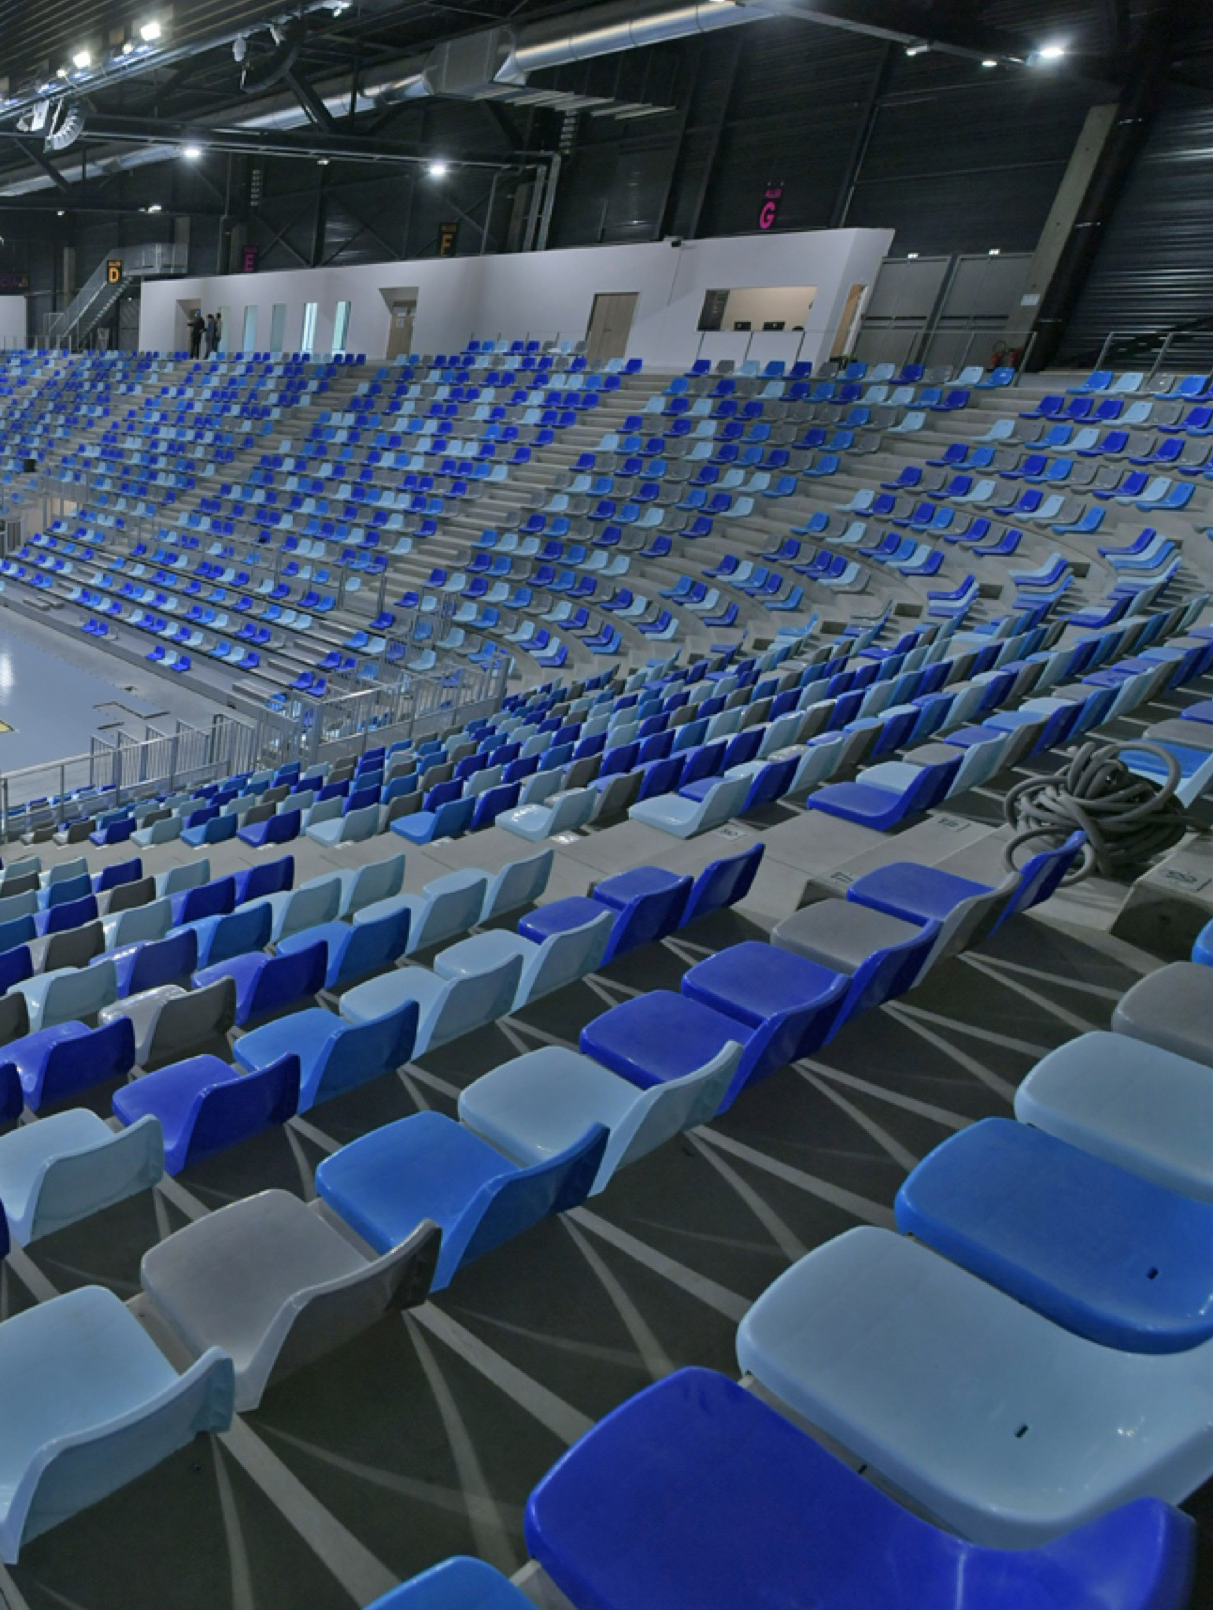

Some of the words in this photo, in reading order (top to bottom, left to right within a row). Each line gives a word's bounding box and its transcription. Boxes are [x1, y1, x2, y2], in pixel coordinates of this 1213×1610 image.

[760, 202, 776, 229] G
[441, 233, 452, 256] F
[244, 254, 253, 272] E
[109, 267, 120, 283] D
